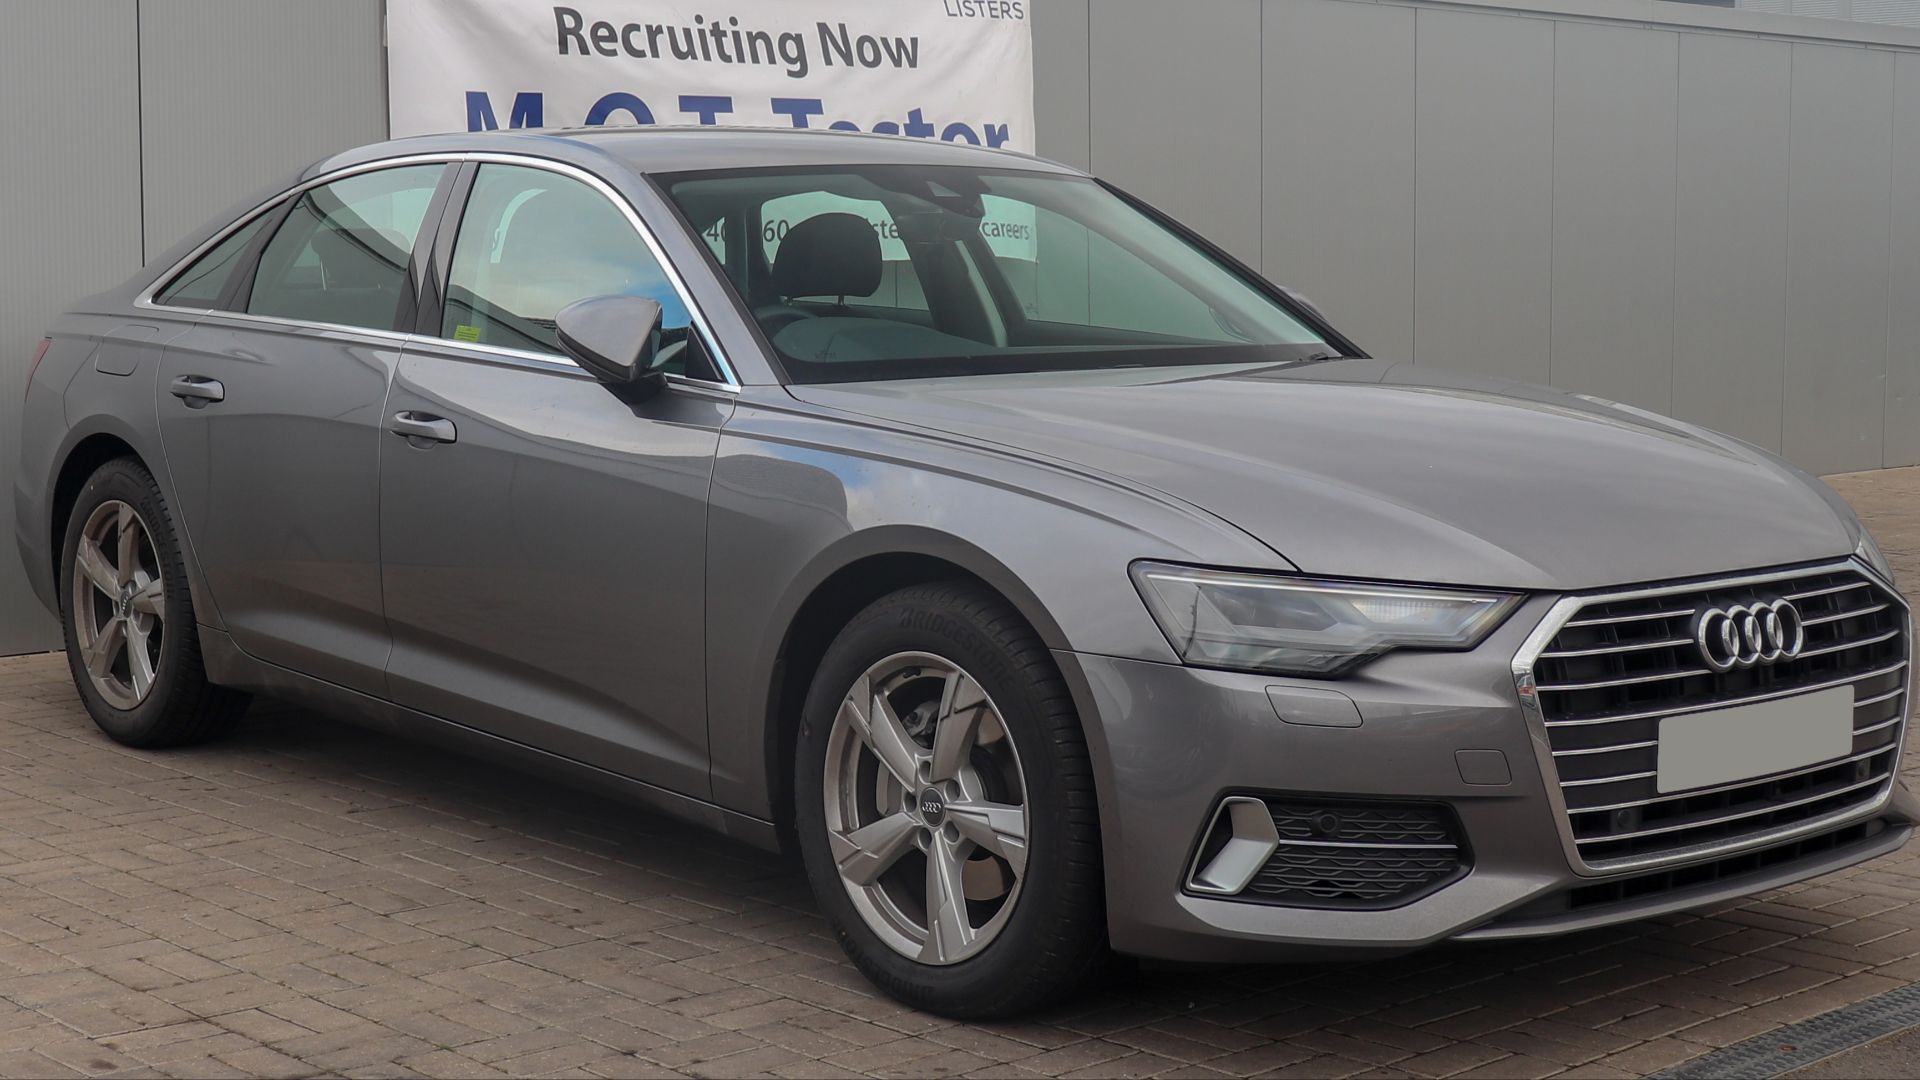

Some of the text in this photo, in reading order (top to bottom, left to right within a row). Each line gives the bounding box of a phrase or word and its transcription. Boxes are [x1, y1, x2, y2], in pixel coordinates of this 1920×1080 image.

[943, 0, 1024, 20] LISTERS
[553, 6, 919, 79] Recruiting Now
[981, 221, 1030, 240] careers
